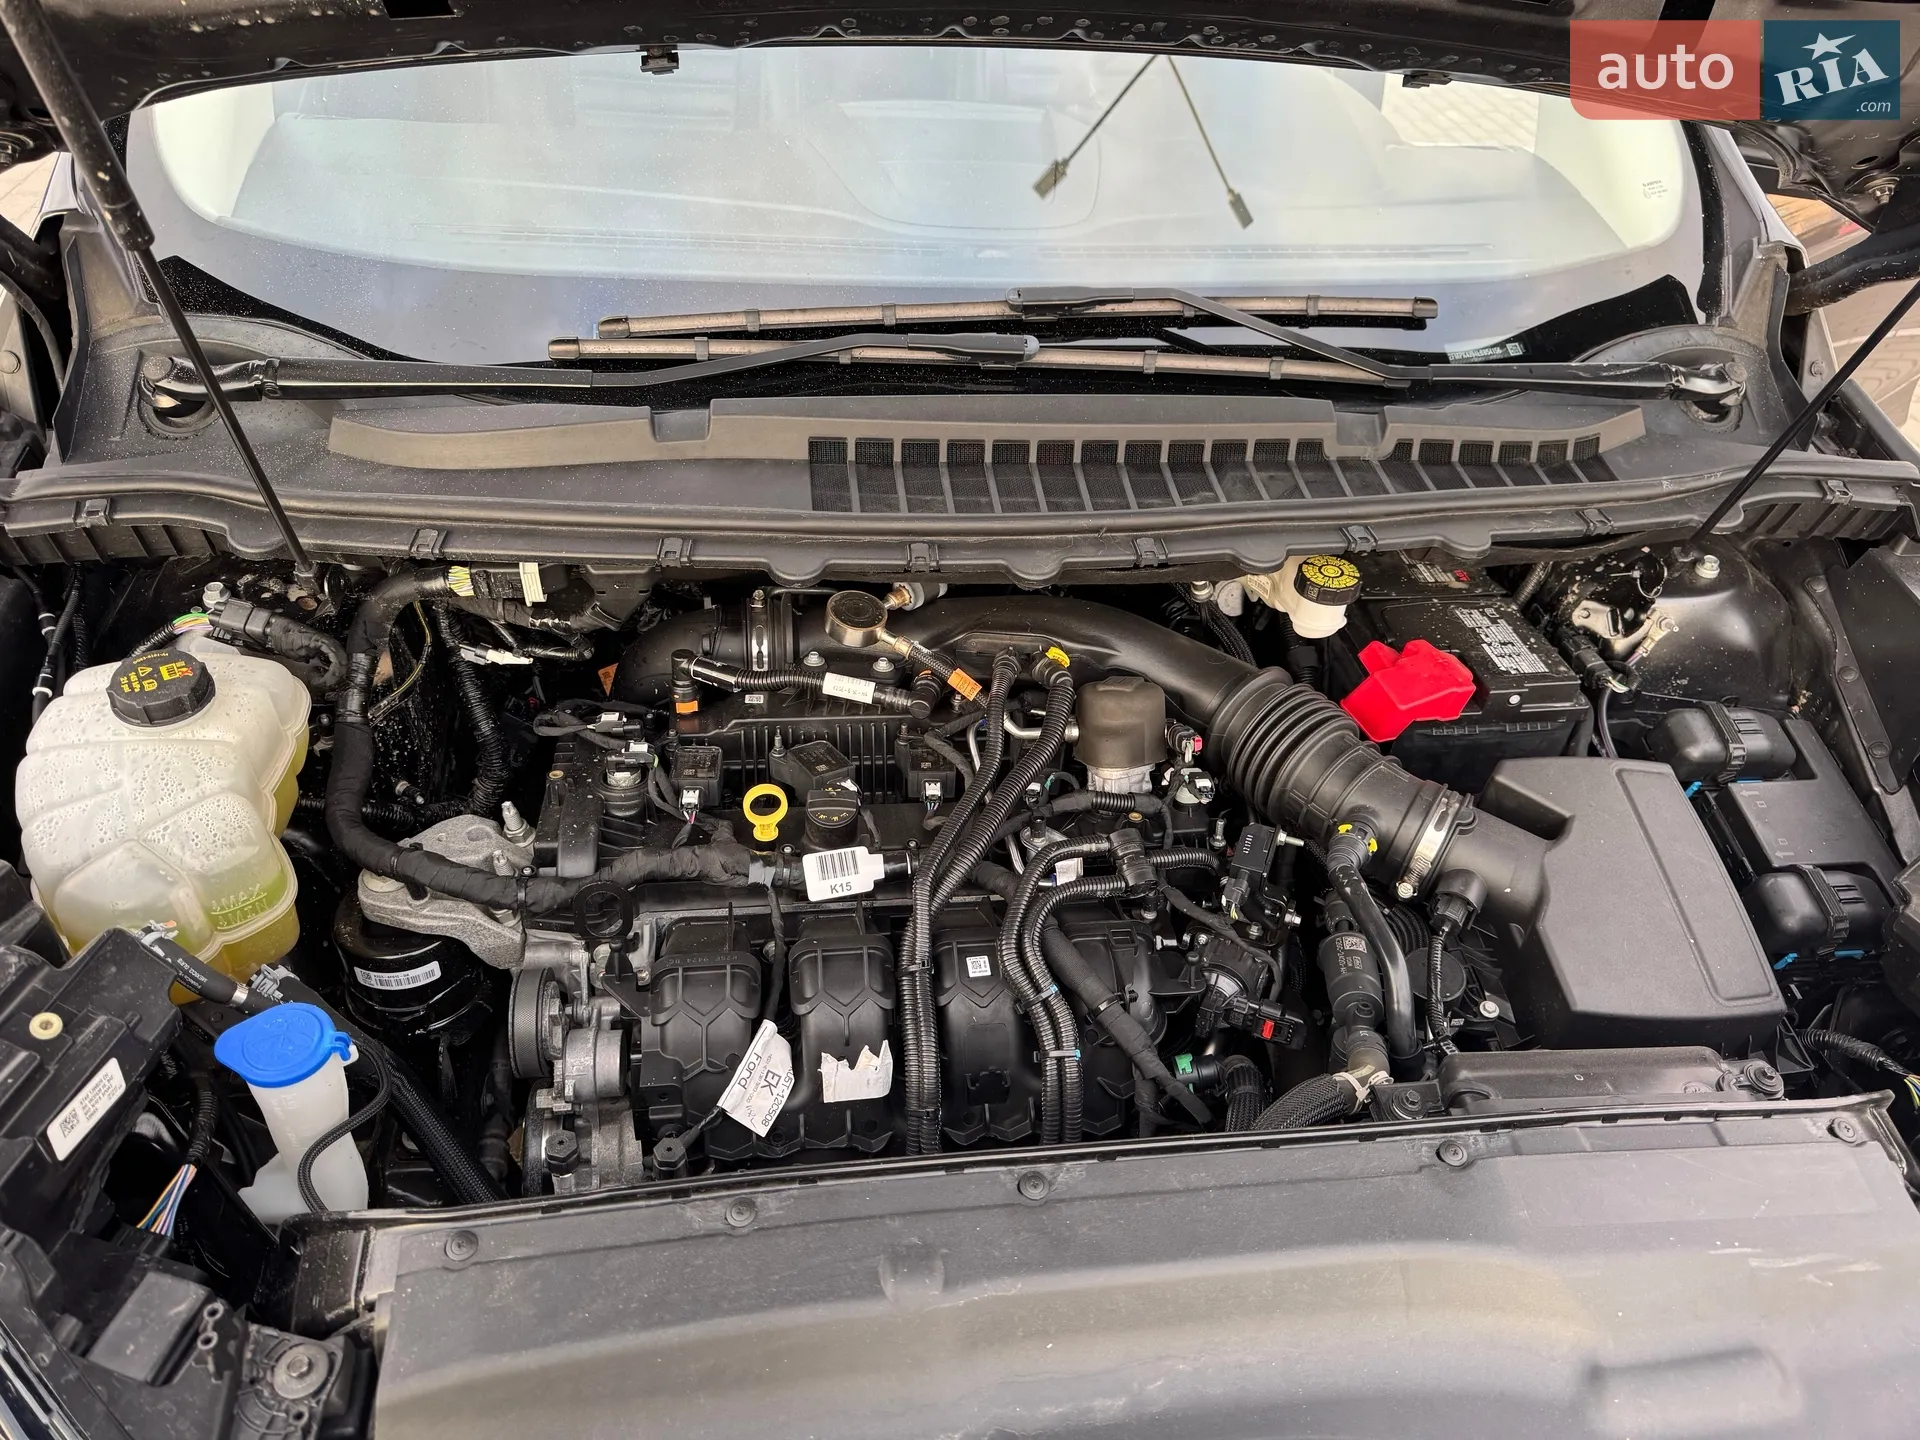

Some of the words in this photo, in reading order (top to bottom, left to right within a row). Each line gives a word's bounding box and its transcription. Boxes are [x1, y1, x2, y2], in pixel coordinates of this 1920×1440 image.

[829, 881, 853, 895] K15
[737, 1052, 763, 1090] Ford
[760, 1069, 783, 1097] EK
